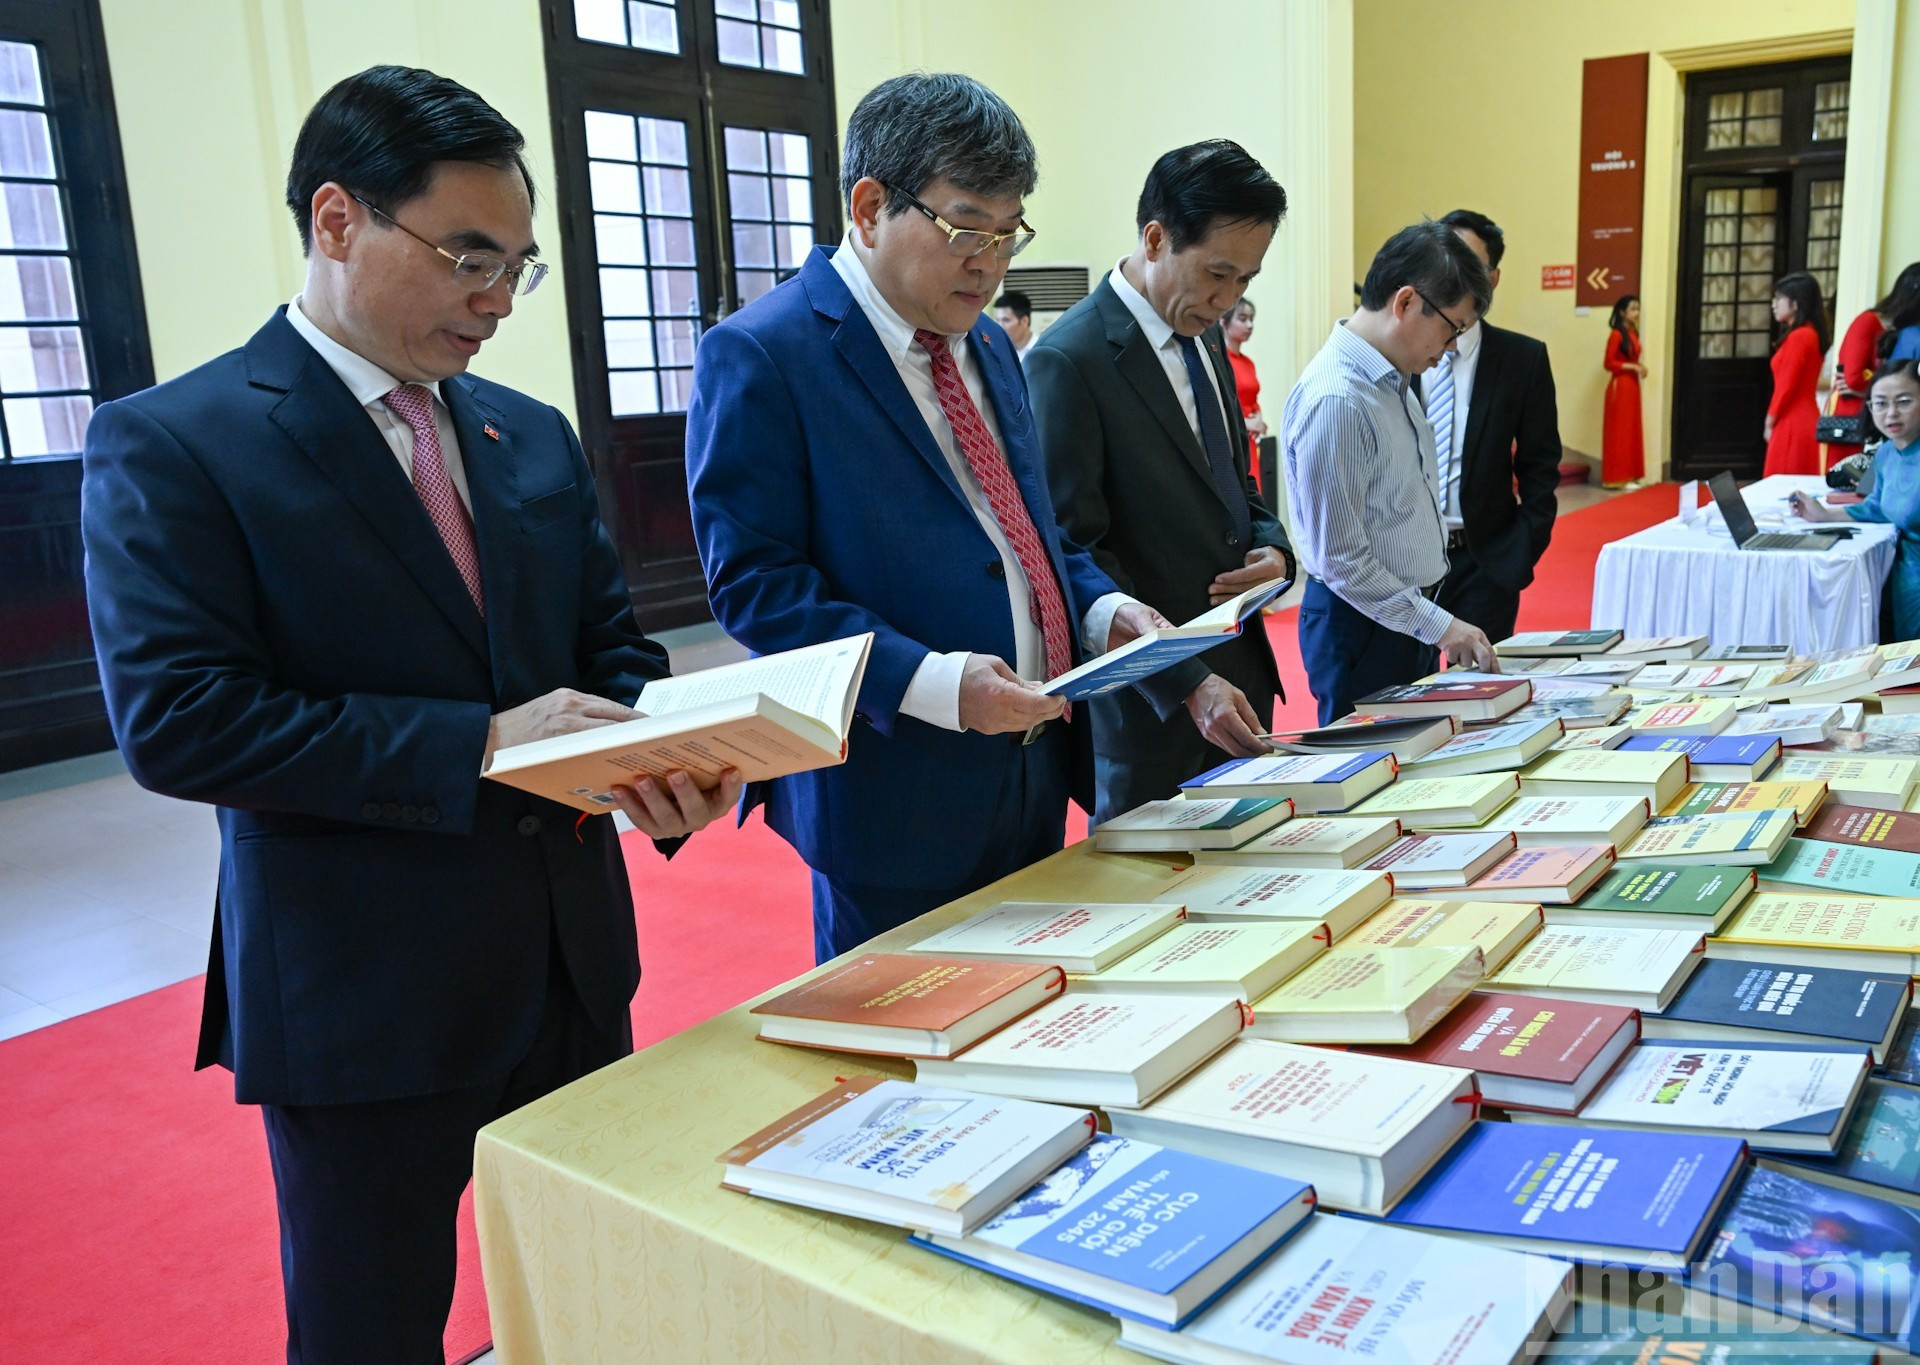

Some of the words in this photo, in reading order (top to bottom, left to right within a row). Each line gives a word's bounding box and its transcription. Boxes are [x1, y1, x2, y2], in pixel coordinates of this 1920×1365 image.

[1794, 901, 1818, 921] QUYỀN
[1821, 903, 1848, 918] KIỂM
[1852, 902, 1876, 917] TĂNG
[1811, 919, 1835, 935] SOÁT
[1840, 918, 1868, 939] CƯỜNG
[1487, 1007, 1513, 1023] QUYỀN
[1458, 1033, 1486, 1051] NGƯỜI
[1672, 1053, 1705, 1075] VIỆT
[1652, 1078, 1688, 1104] NAM
[975, 1109, 999, 1125] XUẤT
[894, 1128, 926, 1146] VIỆT
[925, 1126, 952, 1143] XUẤT
[857, 1147, 897, 1169] NAM
[918, 1141, 955, 1163] ĐIỆN
[877, 1158, 908, 1174] SỐ
[1103, 1180, 1150, 1210] NĂM
[1123, 1192, 1168, 1220] THẾ
[1154, 1192, 1198, 1220] CỤC
[1057, 1211, 1105, 1242] 2045
[1079, 1220, 1125, 1249] GIỚI
[1104, 1222, 1157, 1256] DIỆN
[1311, 1285, 1348, 1311] VĂN
[1396, 1280, 1425, 1302] MỐI
[1333, 1296, 1373, 1328] KINH
[1370, 1303, 1405, 1335] QUAN
[1286, 1312, 1324, 1337] HÓA
[1316, 1330, 1347, 1348] TẾ
[1353, 1337, 1378, 1354] HỆ
